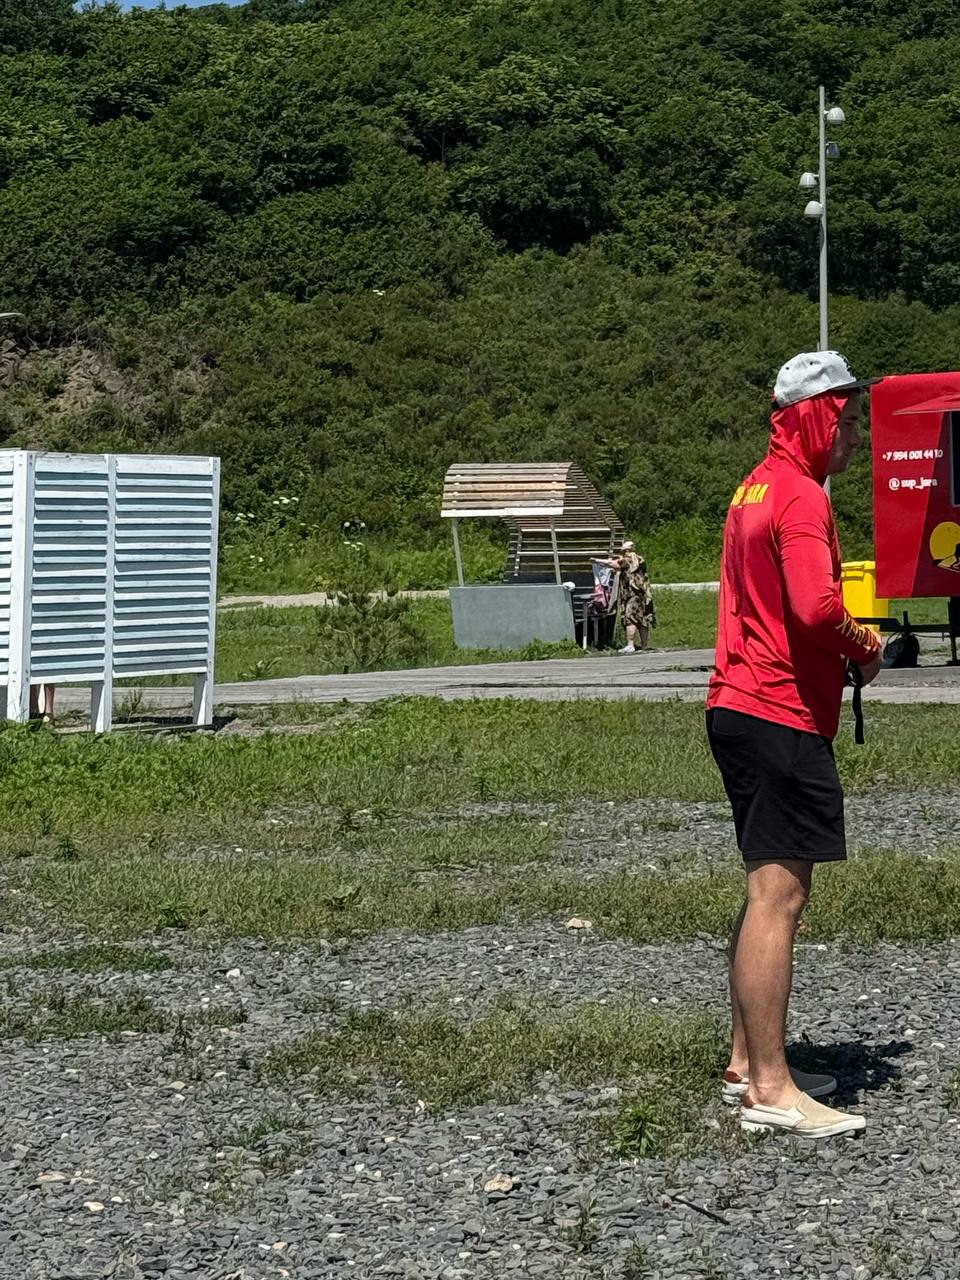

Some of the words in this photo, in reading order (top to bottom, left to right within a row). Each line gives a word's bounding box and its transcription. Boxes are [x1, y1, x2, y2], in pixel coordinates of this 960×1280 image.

[909, 450, 923, 460] 001
[923, 449, 934, 459] 44
[934, 449, 944, 458] 10
